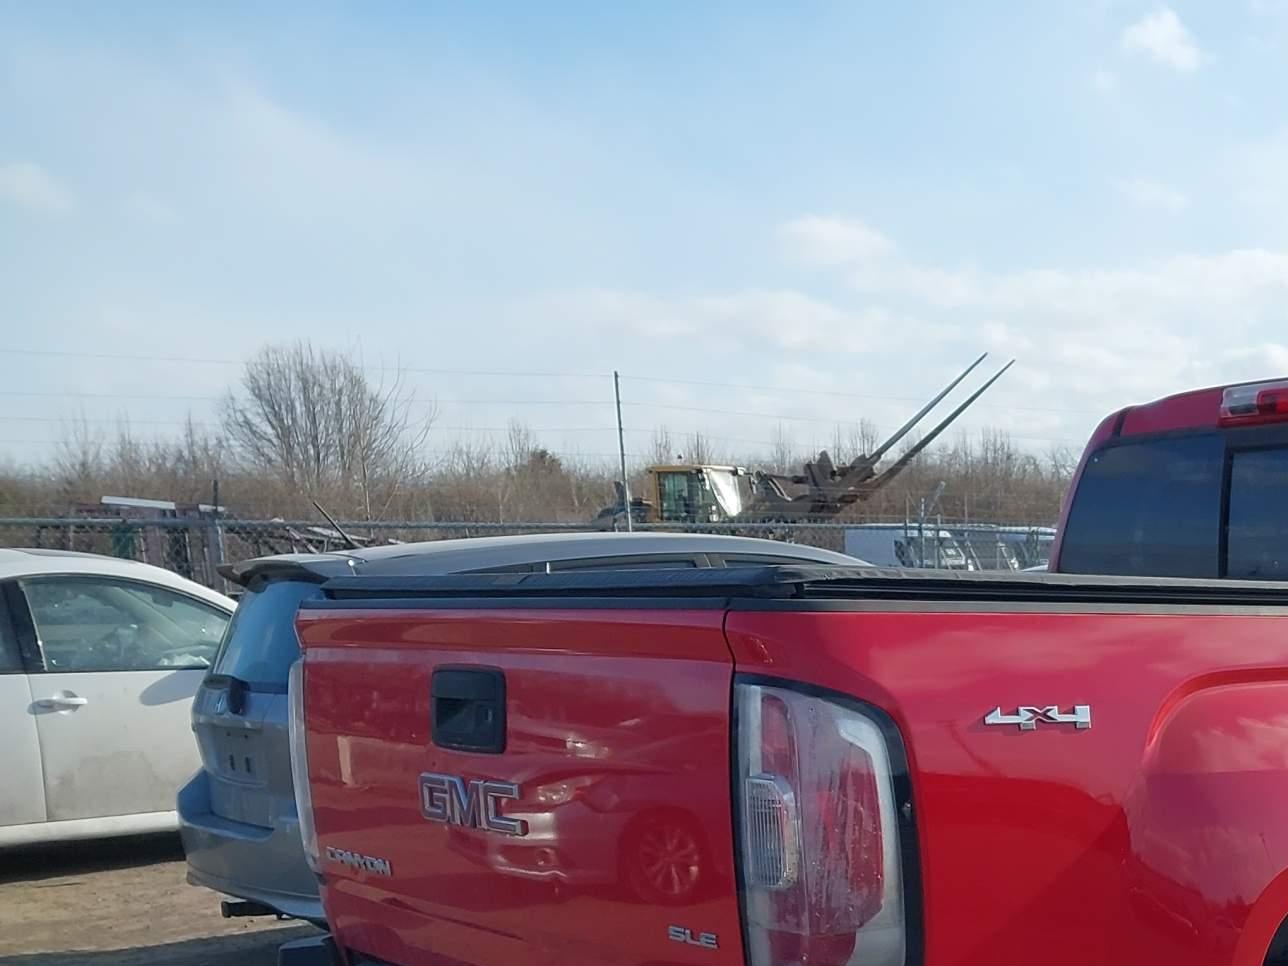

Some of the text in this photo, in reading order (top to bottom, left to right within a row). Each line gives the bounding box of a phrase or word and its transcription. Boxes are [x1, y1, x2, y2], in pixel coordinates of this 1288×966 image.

[418, 772, 529, 836] GMC
[326, 845, 393, 876] CANYON
[667, 924, 719, 949] SLE
